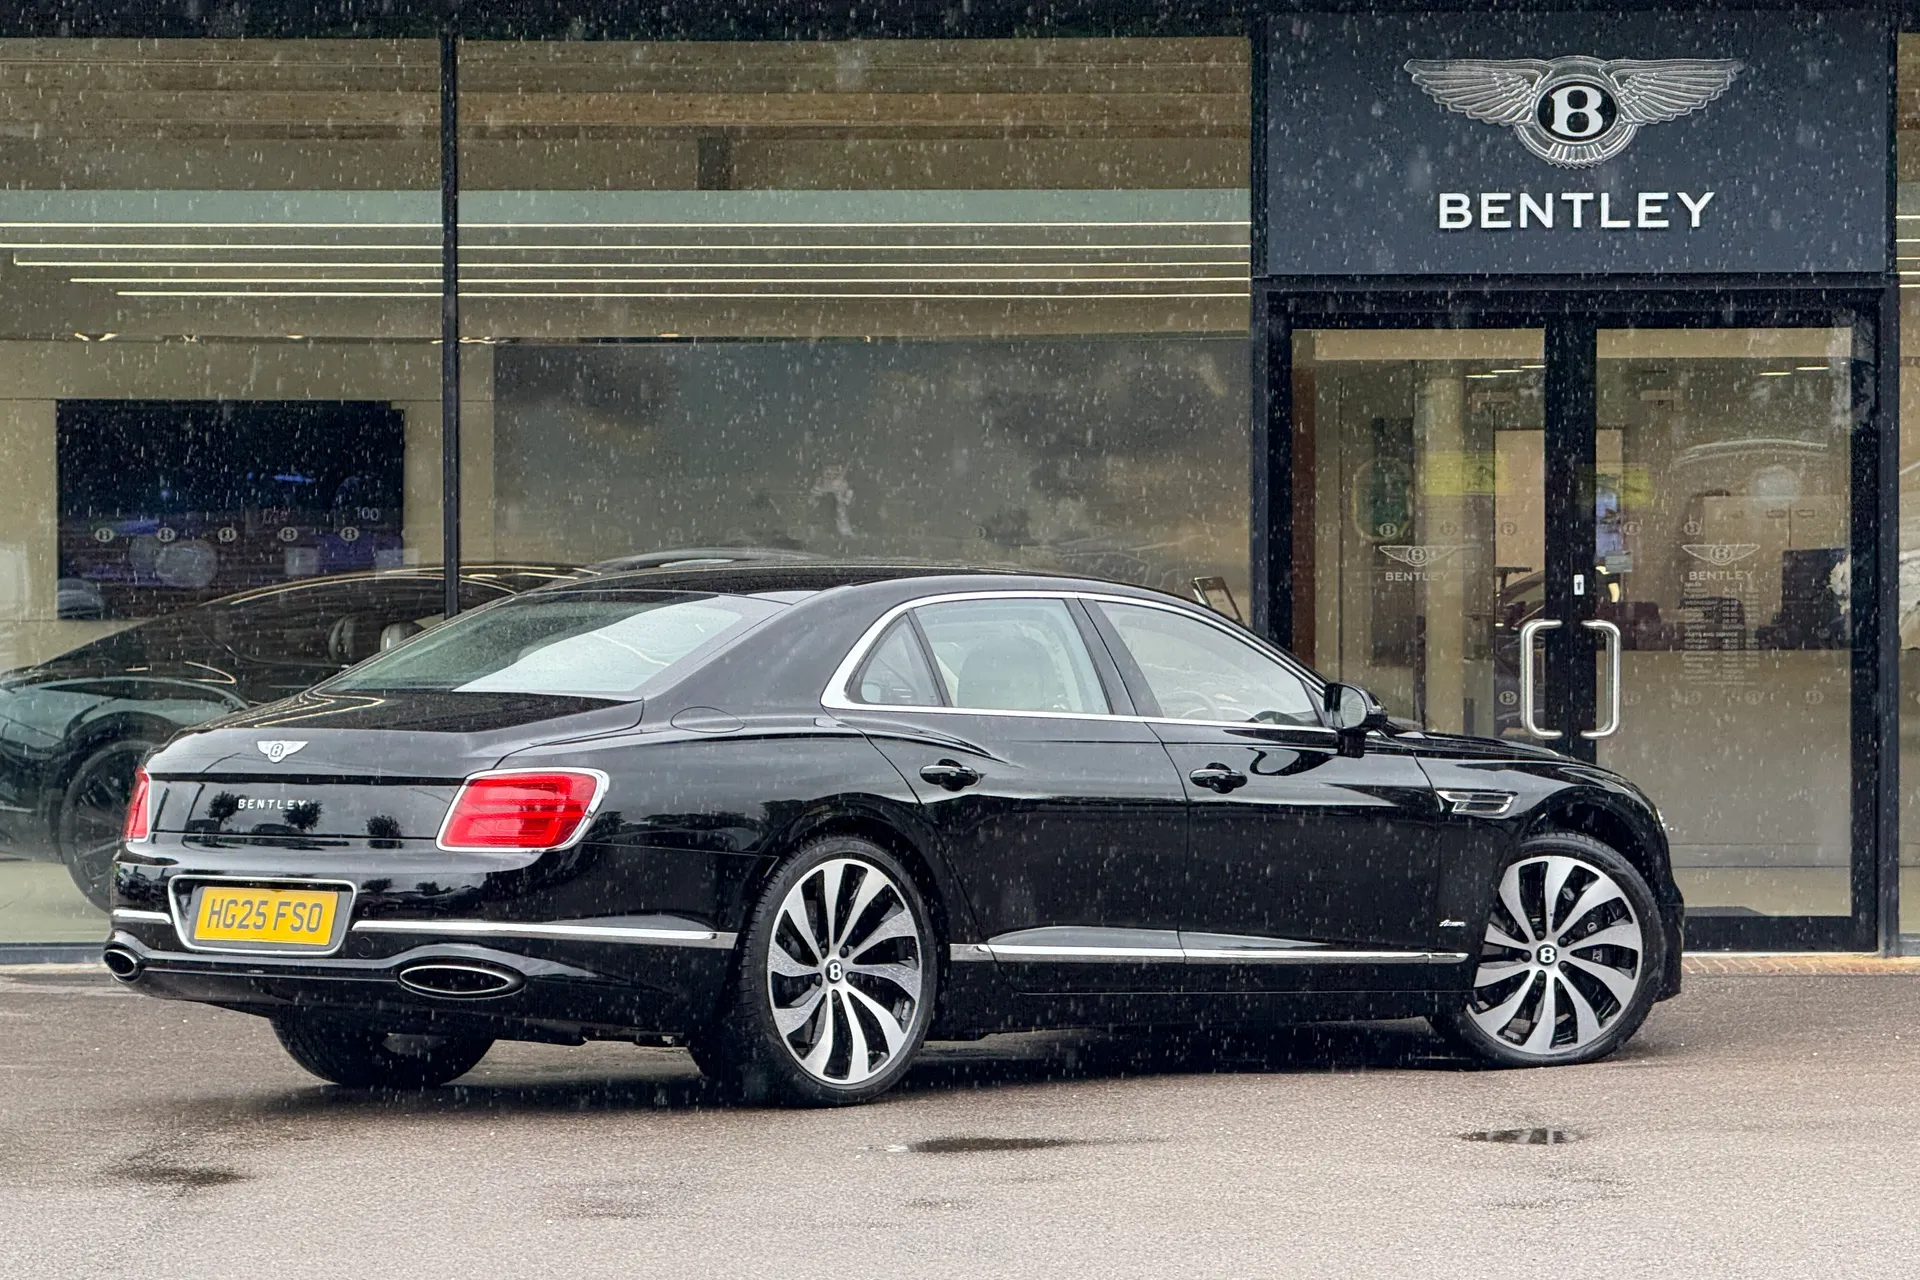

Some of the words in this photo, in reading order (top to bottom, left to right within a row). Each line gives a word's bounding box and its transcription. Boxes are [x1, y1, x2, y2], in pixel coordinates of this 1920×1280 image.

[1551, 85, 1604, 137] B
[1439, 192, 1715, 229] BENTLEY
[1385, 571, 1449, 581] BENTLEY
[1689, 570, 1753, 581] BENTLEY
[238, 798, 306, 810] BENTLEY
[207, 898, 268, 930] HG25
[273, 901, 323, 932] FSO
[1540, 947, 1555, 964] B
[829, 963, 842, 981] B
